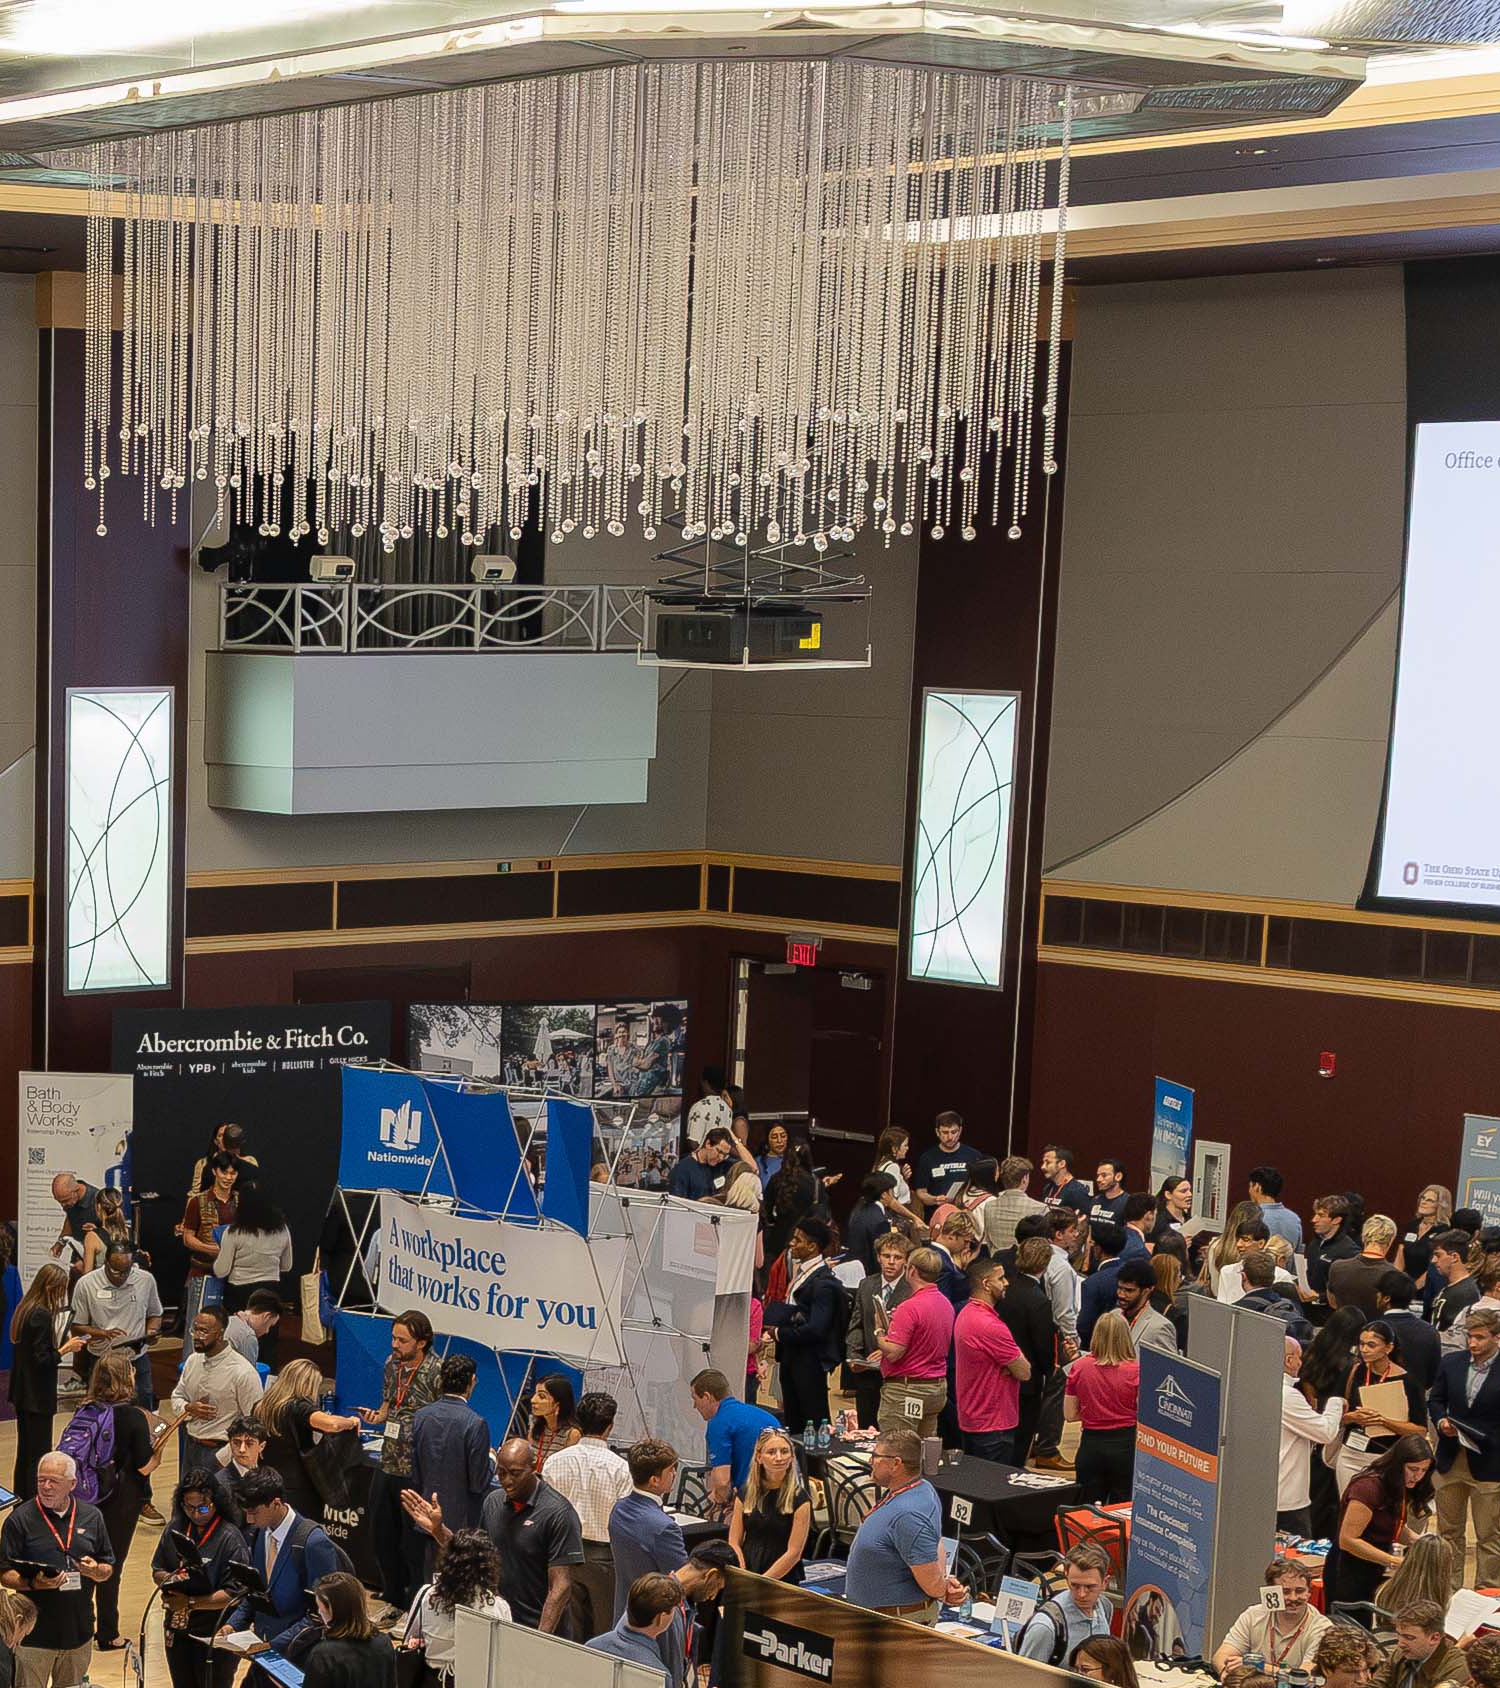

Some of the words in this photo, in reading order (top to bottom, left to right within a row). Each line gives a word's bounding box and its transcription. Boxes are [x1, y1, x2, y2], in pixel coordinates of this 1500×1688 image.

[1445, 450, 1494, 469] Office
[137, 1030, 263, 1054] Abercrombie
[266, 1034, 281, 1049] &
[284, 1026, 335, 1049] Fitch
[337, 1025, 369, 1046] Co.
[26, 1086, 61, 1099] Bath
[27, 1101, 38, 1113] &
[41, 1101, 80, 1116] Body
[1477, 1135, 1493, 1148] EY
[367, 1151, 432, 1166] Nationwide
[1473, 1188, 1490, 1199] Will
[390, 1217, 399, 1248] A
[402, 1230, 505, 1276] workplace
[389, 1255, 413, 1292] that
[417, 1273, 480, 1311] works
[487, 1283, 529, 1320] for
[536, 1299, 597, 1330] you
[1137, 1431, 1155, 1449] FIND
[1156, 1441, 1177, 1459] YOUR
[1179, 1451, 1210, 1474] FUTURE
[955, 1503, 967, 1521] 82
[1266, 1593, 1281, 1610] 83
[760, 1629, 833, 1678] Parker
